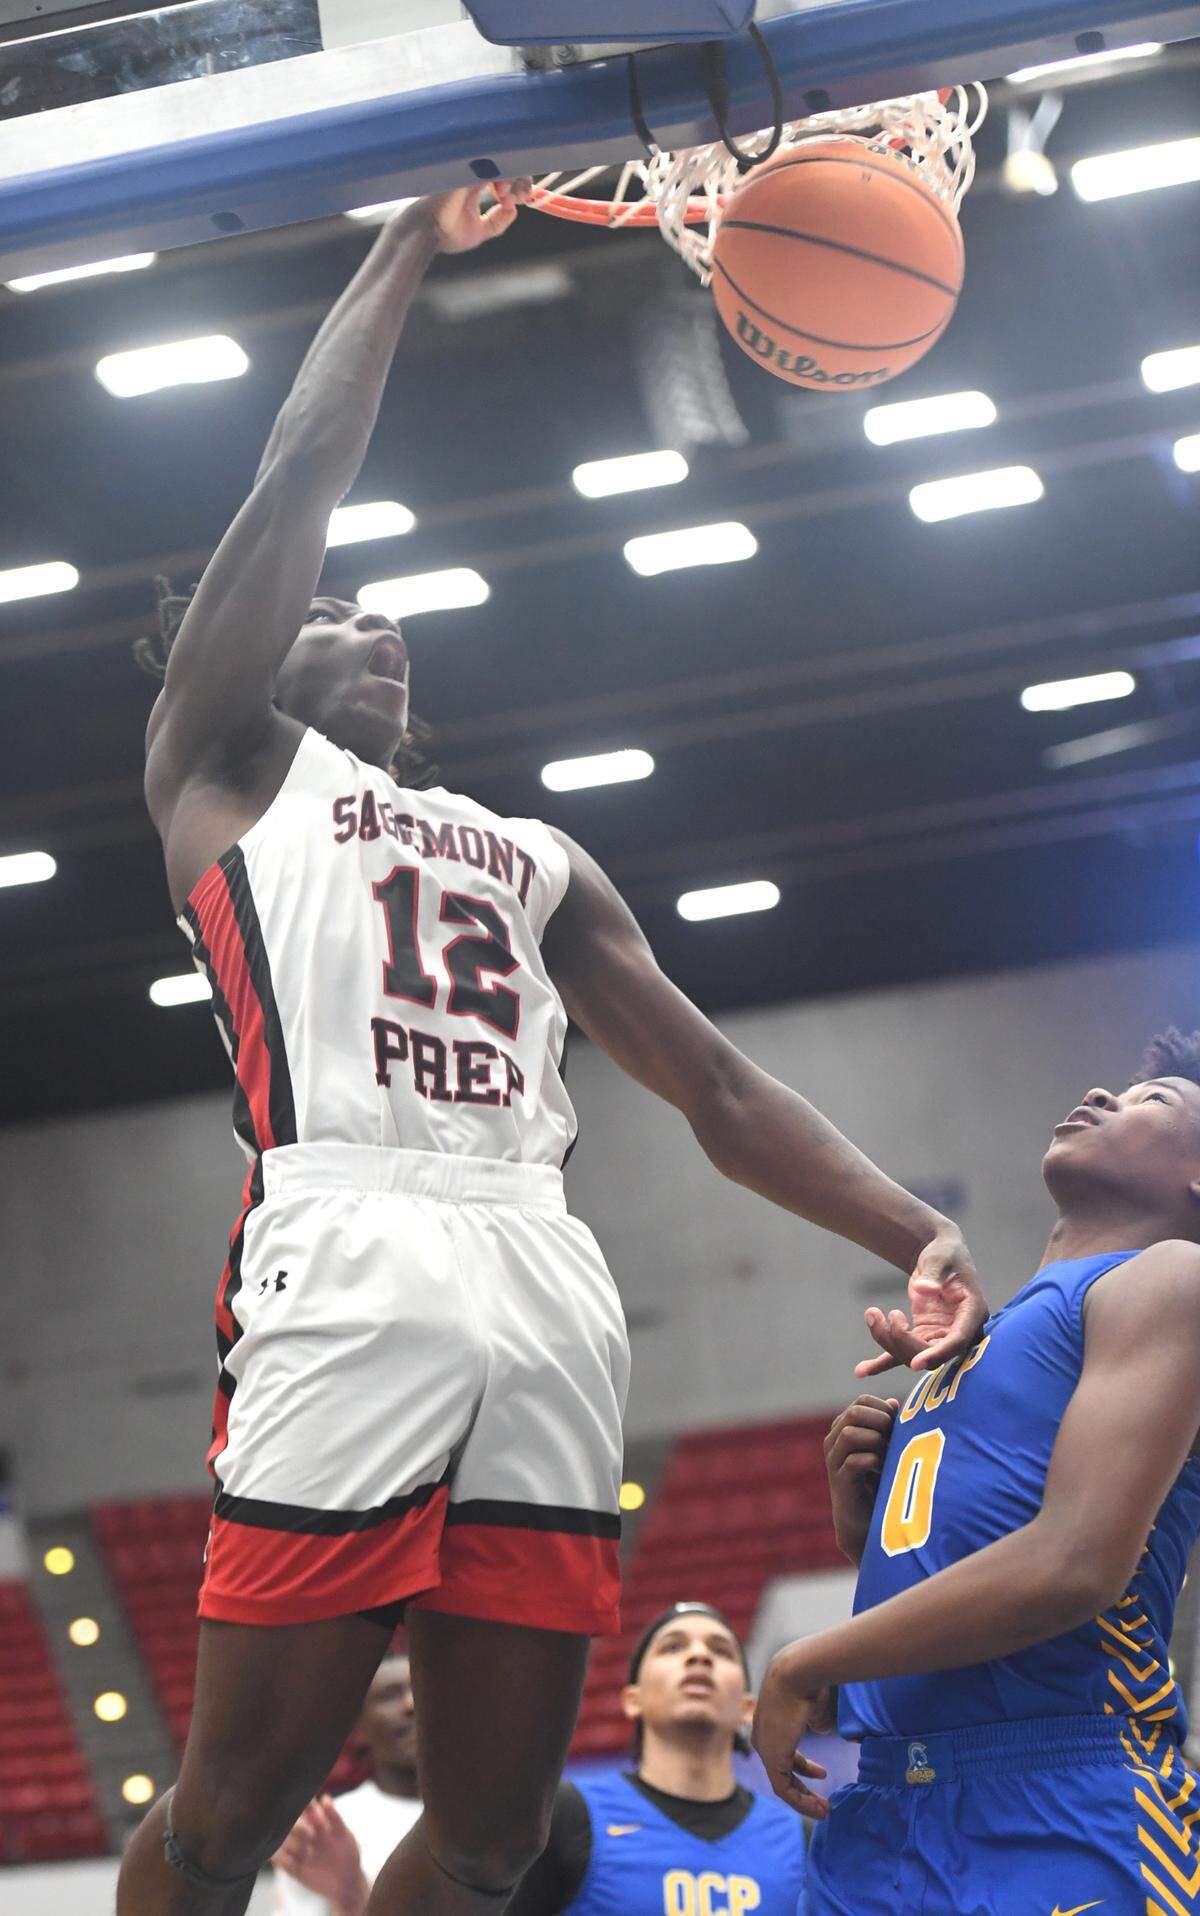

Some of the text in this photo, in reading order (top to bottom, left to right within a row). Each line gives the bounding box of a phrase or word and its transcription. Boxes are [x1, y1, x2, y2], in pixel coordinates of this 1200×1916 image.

[736, 311, 889, 384] Wilson
[371, 865, 521, 1041] 12
[900, 1335, 991, 1424] OCP
[881, 1427, 946, 1558] 0
[663, 1869, 761, 1916] OCP
